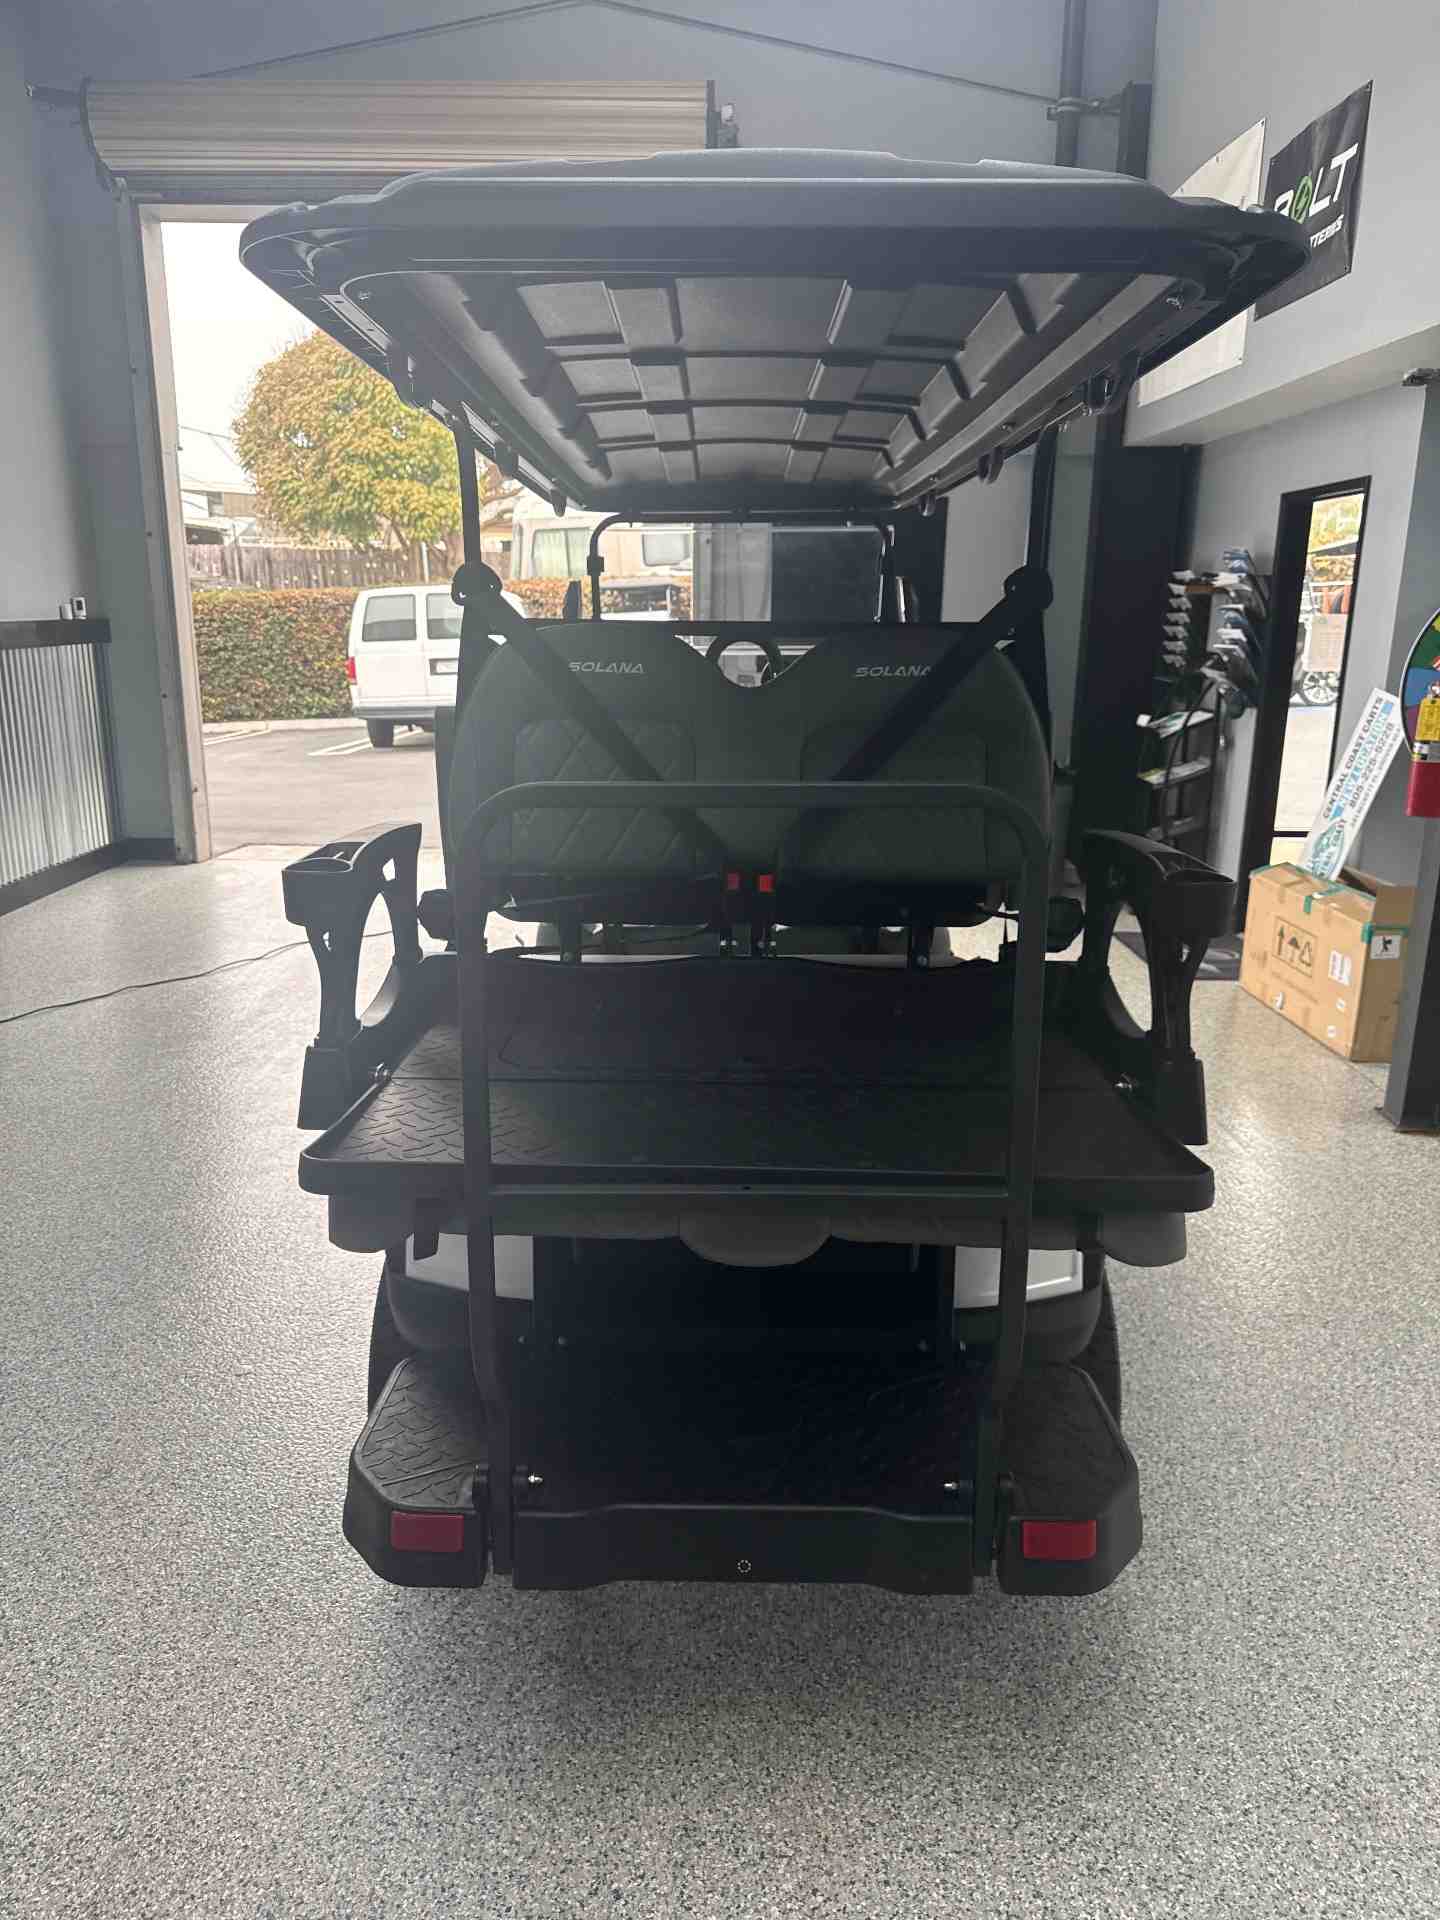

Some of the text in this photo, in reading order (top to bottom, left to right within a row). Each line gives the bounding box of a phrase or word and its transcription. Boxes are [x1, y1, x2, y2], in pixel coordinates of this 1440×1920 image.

[568, 661, 644, 673] SOLANA
[1322, 772, 1349, 819] CENTRAL
[1344, 735, 1365, 770] COAST
[1362, 696, 1383, 733] CARTS
